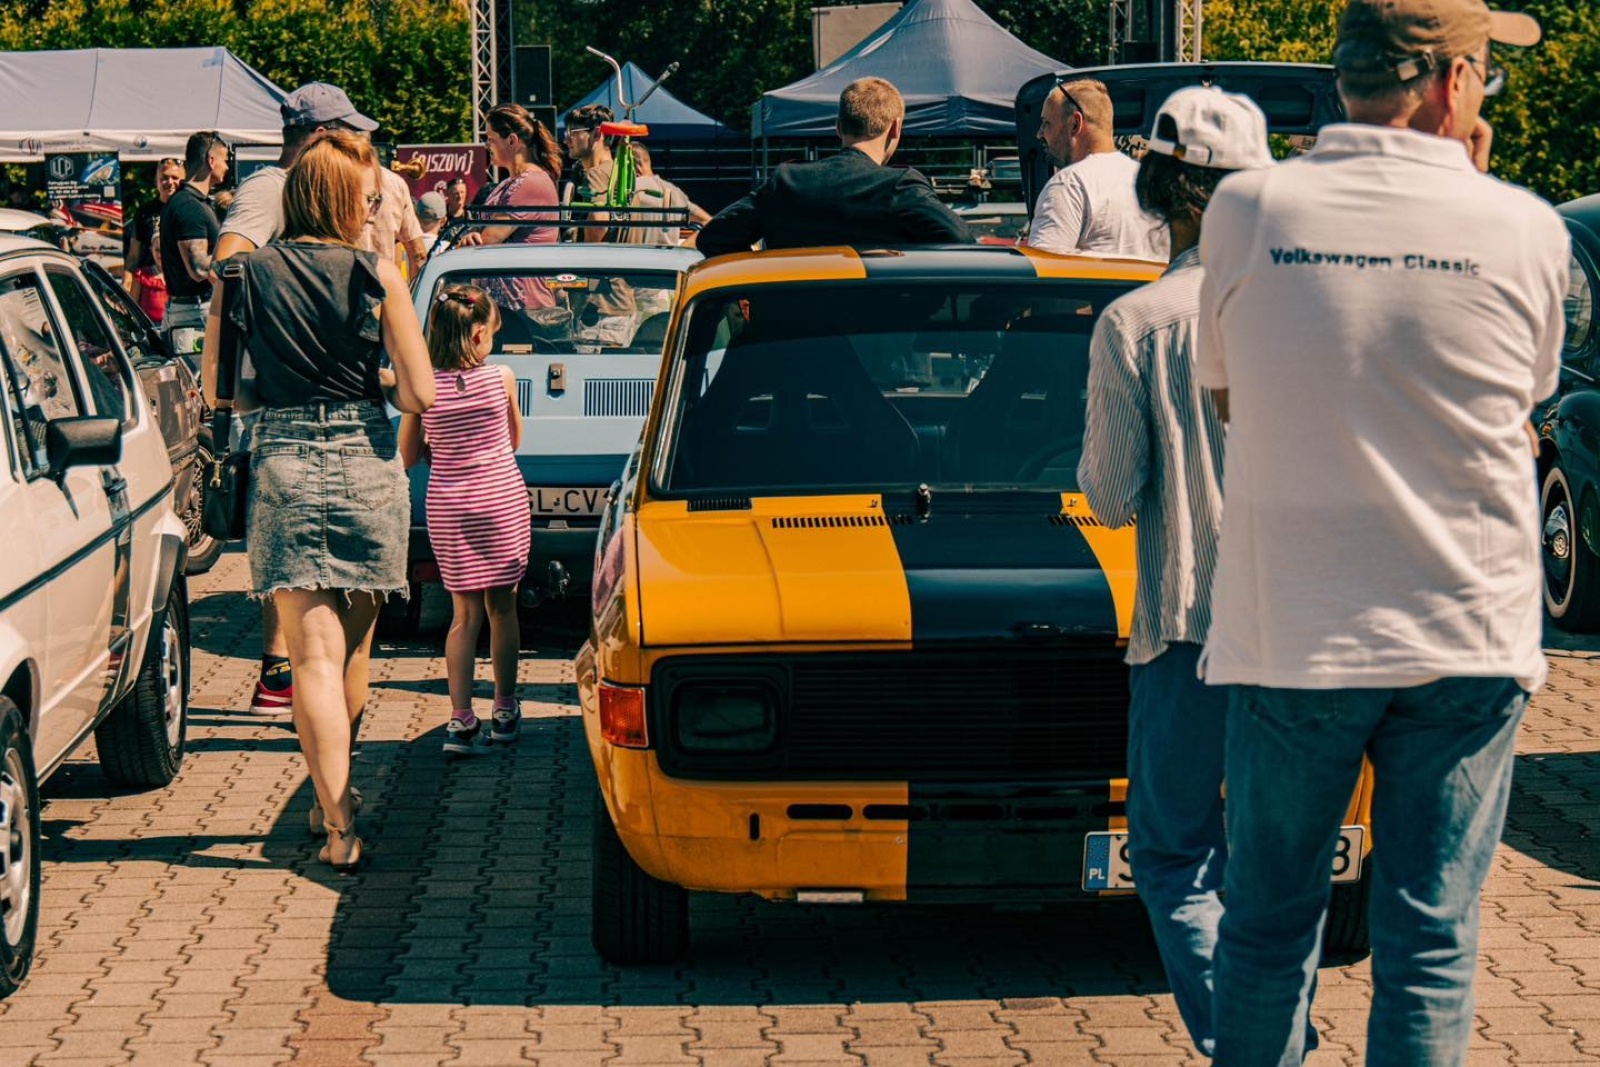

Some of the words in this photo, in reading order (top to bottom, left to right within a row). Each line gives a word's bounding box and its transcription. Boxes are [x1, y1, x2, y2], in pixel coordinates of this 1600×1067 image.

[52, 158, 72, 179] LCP
[1269, 248, 1392, 269] Volkswagen
[1403, 254, 1480, 276] Classic
[564, 489, 610, 513] CV
[1088, 867, 1105, 880] PL
